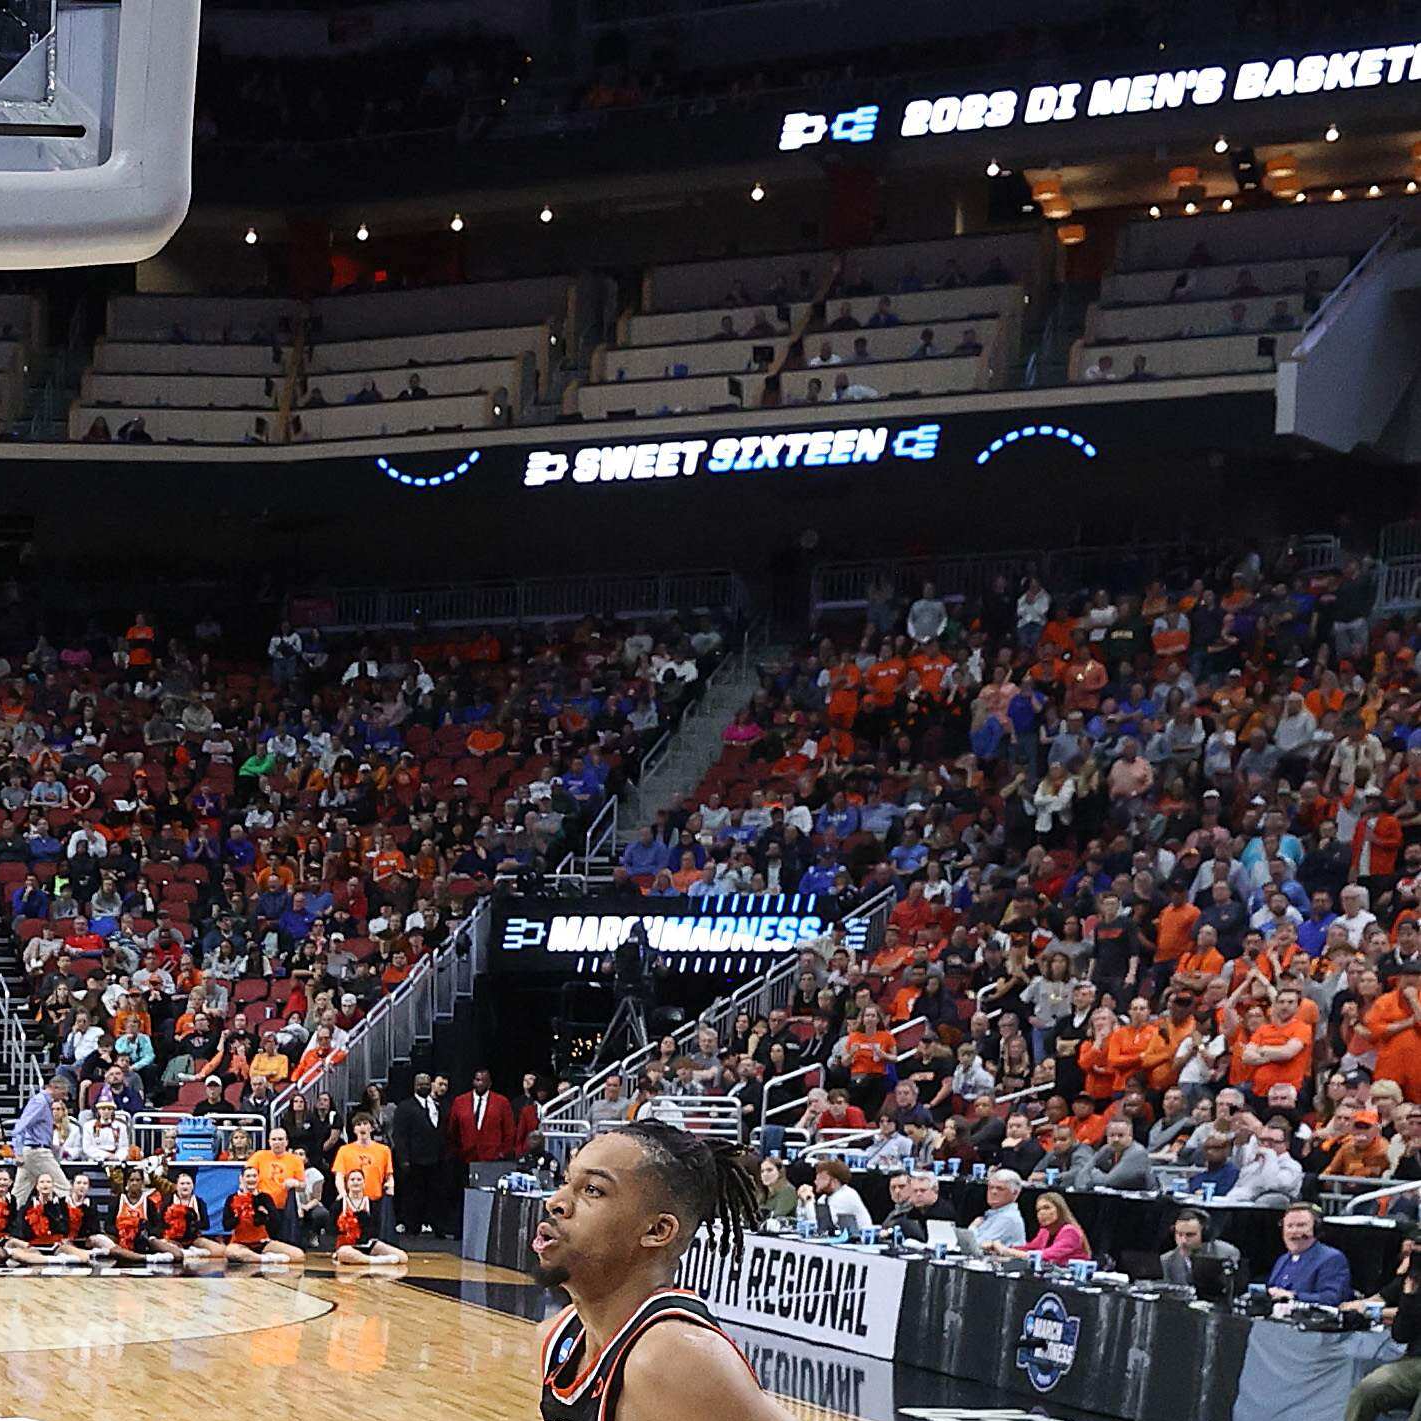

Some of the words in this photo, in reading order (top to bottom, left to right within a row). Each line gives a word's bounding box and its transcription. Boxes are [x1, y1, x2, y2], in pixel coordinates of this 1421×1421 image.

[901, 91, 1018, 137] 2023
[1023, 83, 1082, 124] DI
[1087, 66, 1227, 116] MEN'S
[1232, 43, 1421, 100] BASKET
[572, 440, 708, 483] SWEET
[708, 427, 889, 473] SIXTEEN
[673, 1236, 743, 1308] OUTH
[746, 1247, 869, 1338] REGIONAL
